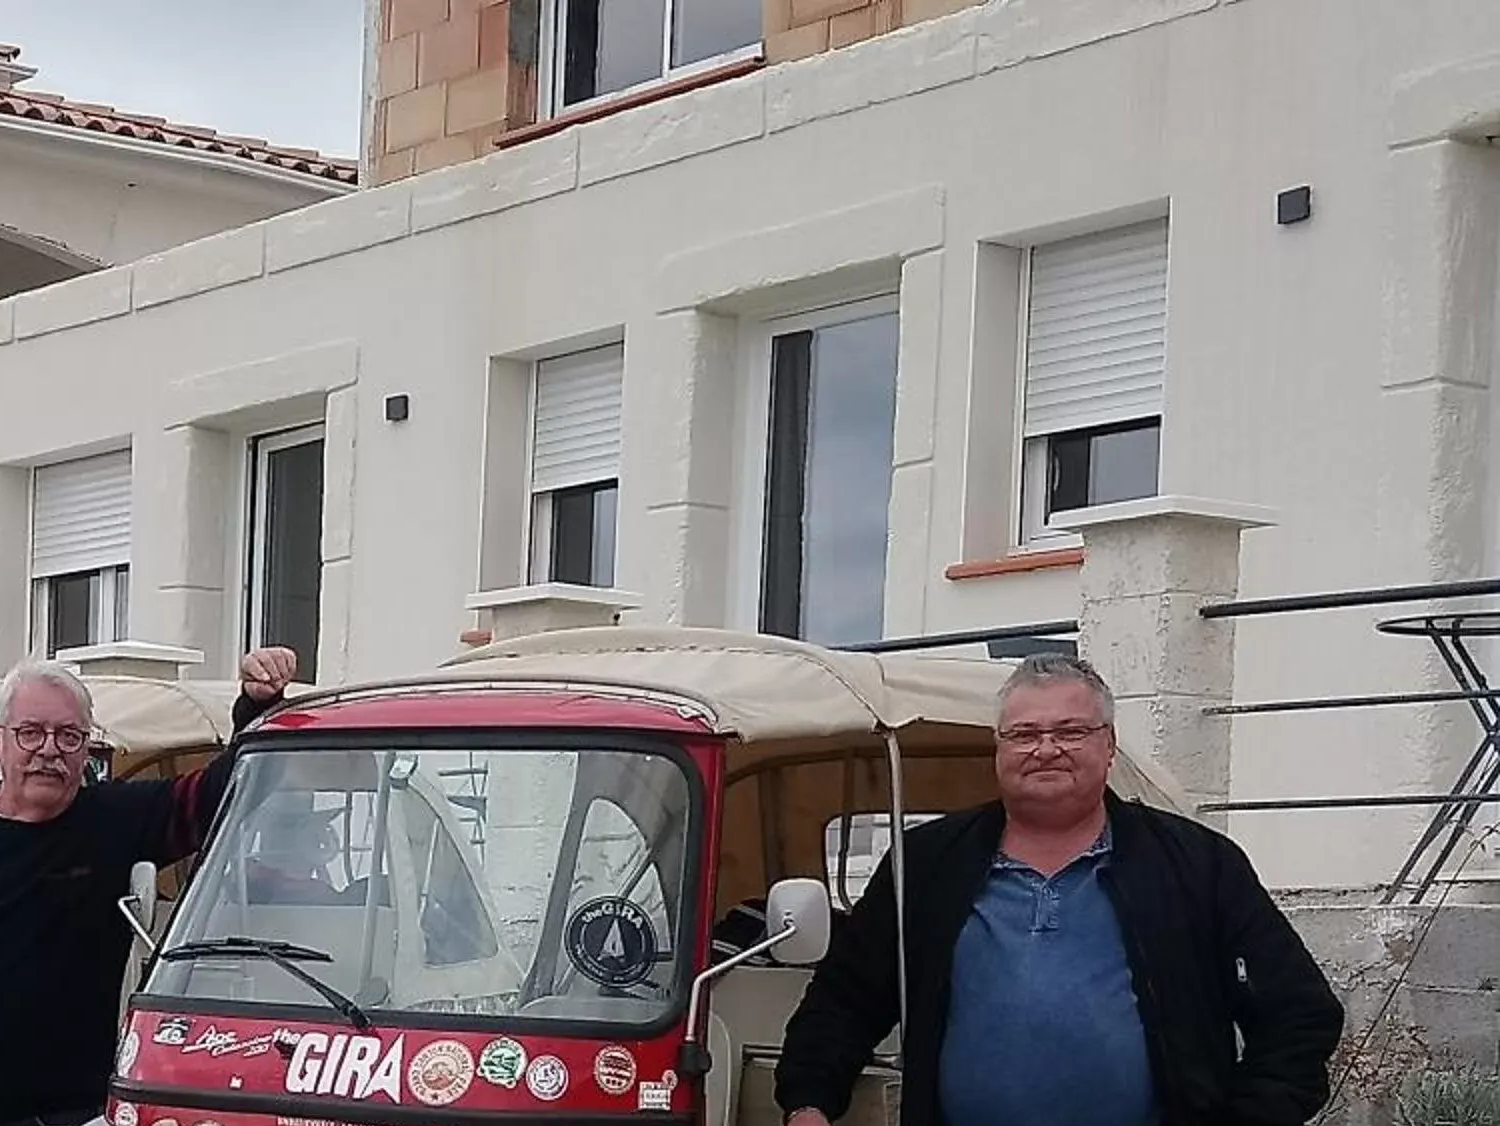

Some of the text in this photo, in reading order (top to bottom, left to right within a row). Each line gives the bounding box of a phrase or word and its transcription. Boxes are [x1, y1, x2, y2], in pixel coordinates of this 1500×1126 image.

[601, 902, 644, 929] GIRA
[272, 1027, 405, 1103] the GIRA
